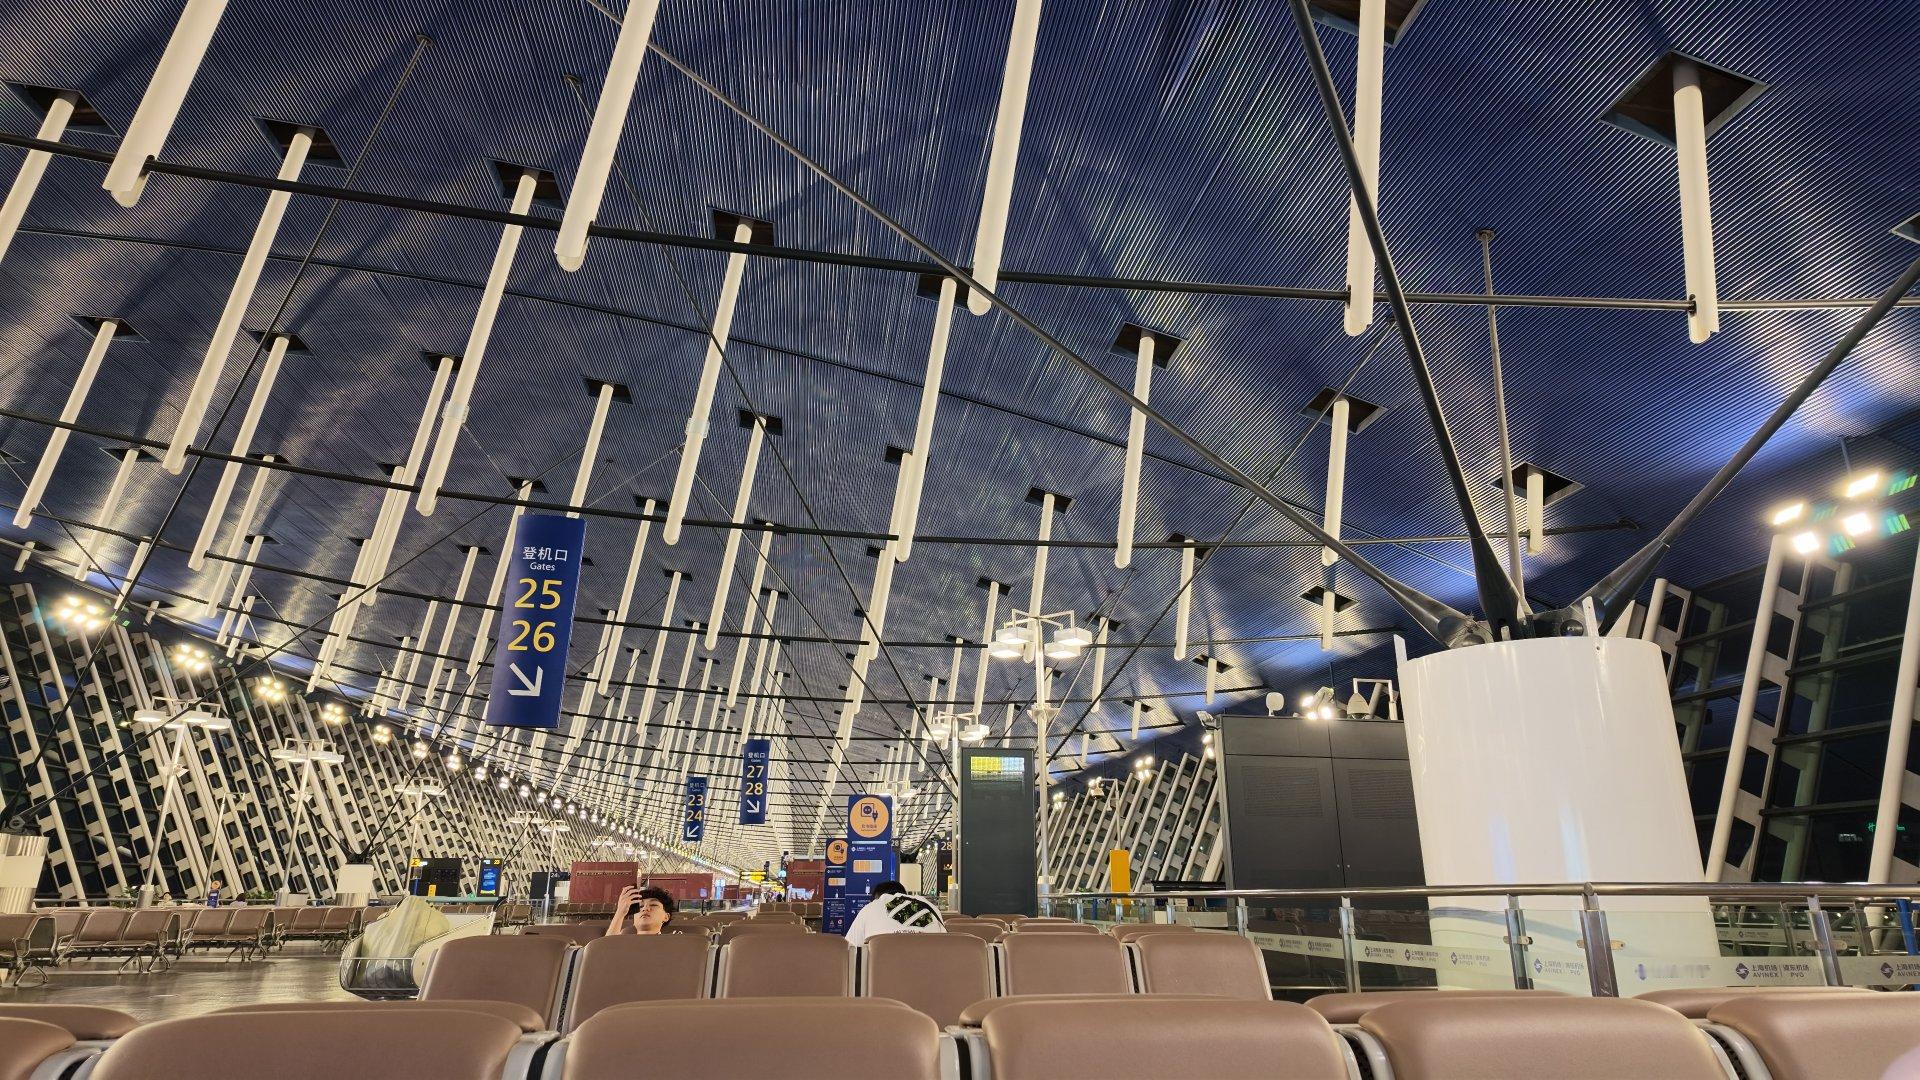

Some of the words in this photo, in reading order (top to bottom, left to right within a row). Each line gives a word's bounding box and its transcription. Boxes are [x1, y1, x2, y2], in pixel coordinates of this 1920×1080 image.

[522, 546, 568, 562] 登机口
[530, 561, 556, 571] Gates
[514, 578, 562, 610] 25
[507, 619, 557, 653] 26
[746, 765, 765, 778] 27
[745, 782, 763, 796] 28
[687, 794, 704, 806] 23
[686, 809, 703, 821] 24
[940, 841, 953, 851] 28
[1752, 964, 1778, 972] 上海机场
